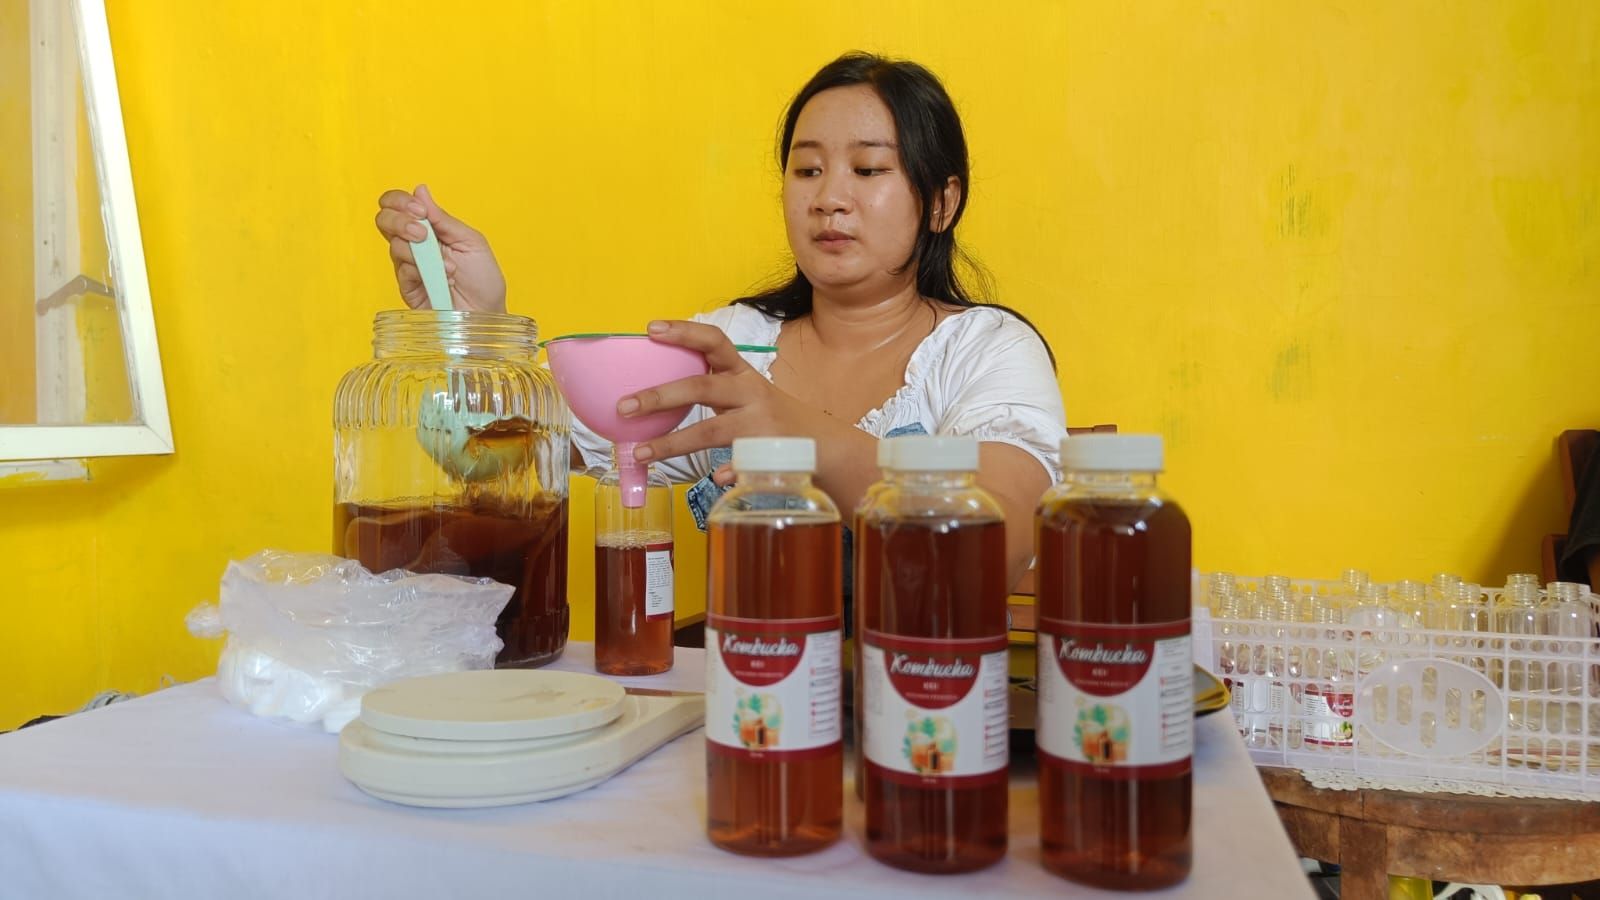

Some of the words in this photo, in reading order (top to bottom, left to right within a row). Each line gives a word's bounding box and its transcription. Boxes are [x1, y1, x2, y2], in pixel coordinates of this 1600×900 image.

[723, 633, 800, 656] Kombucha
[1059, 637, 1147, 663] Kombucha
[890, 652, 974, 678] Kombucha
